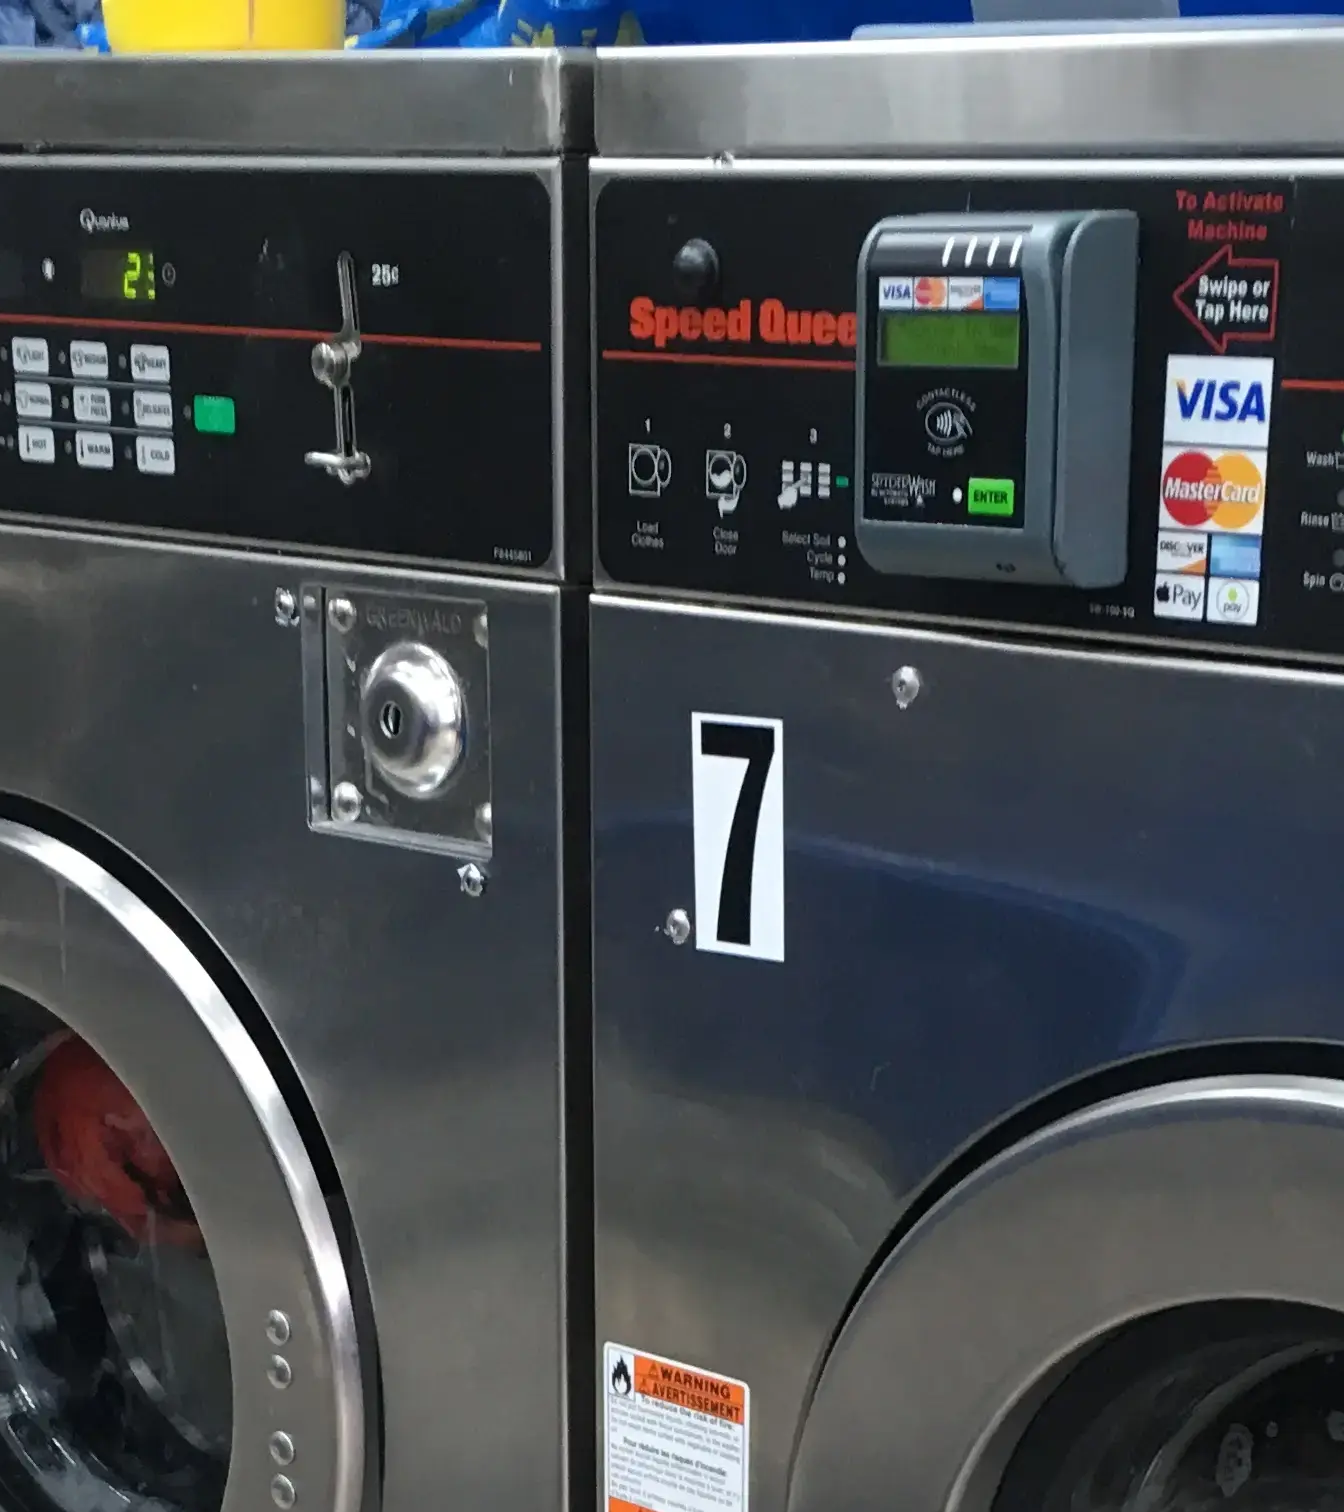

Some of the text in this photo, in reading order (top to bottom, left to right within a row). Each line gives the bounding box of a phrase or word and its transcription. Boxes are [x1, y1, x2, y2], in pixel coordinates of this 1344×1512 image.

[1176, 189, 1284, 212] To Activate
[1187, 219, 1268, 240] Machine
[883, 284, 911, 300] VISA
[1198, 274, 1271, 301] Swipe or
[629, 296, 751, 348] Speed
[759, 298, 856, 346] Quee
[1195, 299, 1269, 325] Tap Here
[1173, 378, 1266, 423] VISA
[1306, 451, 1334, 467] Wash
[973, 490, 1008, 505] ENTER
[1164, 477, 1262, 505] MasterCard
[1300, 511, 1329, 527] Rinse
[1303, 571, 1325, 590] Spin
[1172, 583, 1202, 611] Pay
[700, 720, 775, 946] 7
[661, 1367, 731, 1400] WARNING
[652, 1383, 740, 1420] AVERTISSEMENT
